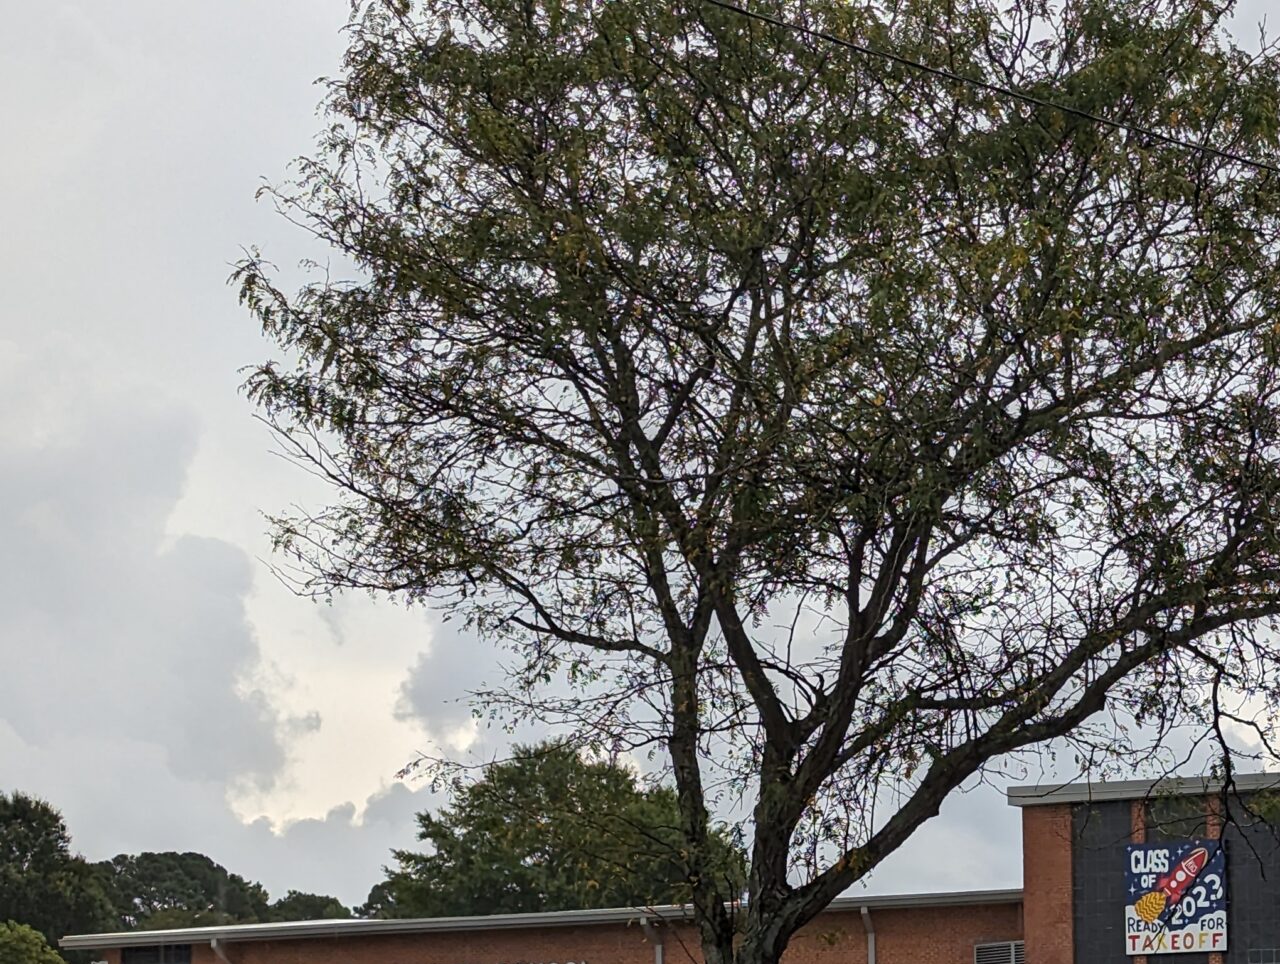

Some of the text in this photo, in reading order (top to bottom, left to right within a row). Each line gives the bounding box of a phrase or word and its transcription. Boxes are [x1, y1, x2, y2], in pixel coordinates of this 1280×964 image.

[1131, 849, 1169, 873] CLASS
[1141, 874, 1156, 888] OF
[1169, 874, 1223, 924] 2023
[1127, 917, 1224, 933] READY FOR
[1128, 933, 1223, 951] TAKEOFF
